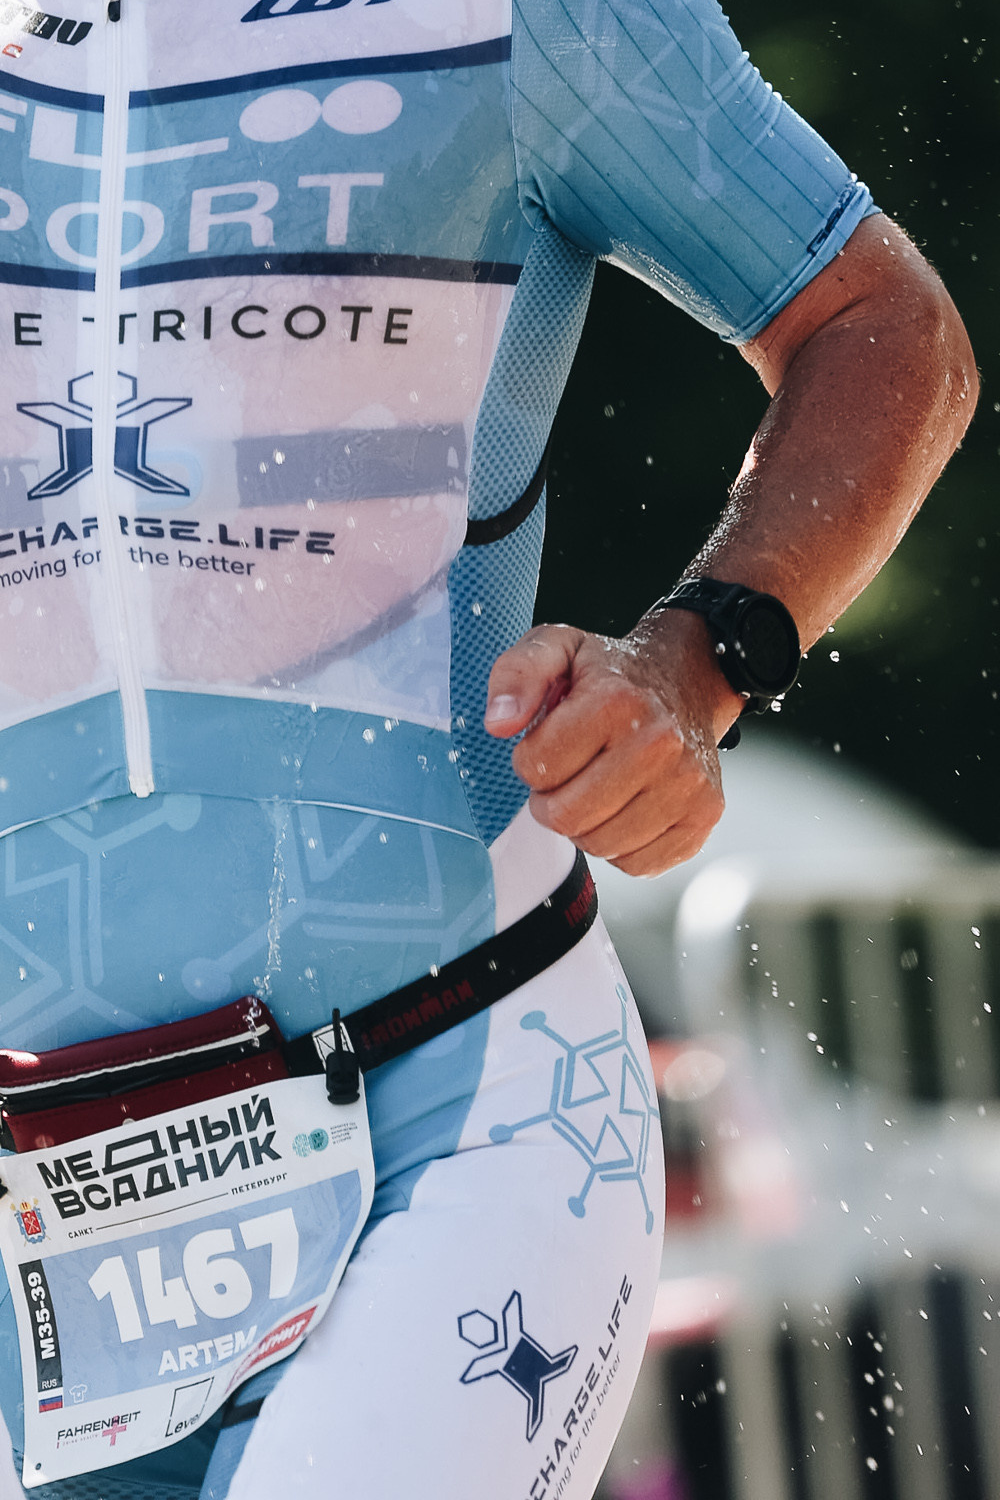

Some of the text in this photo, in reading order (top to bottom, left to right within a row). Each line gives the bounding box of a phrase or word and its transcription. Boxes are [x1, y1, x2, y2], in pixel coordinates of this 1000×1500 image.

[82, 305, 414, 345] TRICOTE
[73, 547, 101, 567] for
[128, 545, 171, 566] the
[177, 550, 256, 576] better
[36, 1094, 275, 1189] МЕДНЫЙ
[51, 1130, 282, 1219] ВСАДНИК
[68, 1173, 289, 1239] САНКТ ПЕТЕРБУРГ
[87, 1207, 299, 1344] 1467
[26, 1271, 56, 1359] M35-39
[157, 1325, 258, 1376] ARTEM
[41, 1379, 58, 1389] RUS
[569, 1441, 583, 1466] for
[582, 1406, 597, 1438] the
[597, 1351, 622, 1407] better
[57, 1410, 141, 1442] FAHRENHEIT
